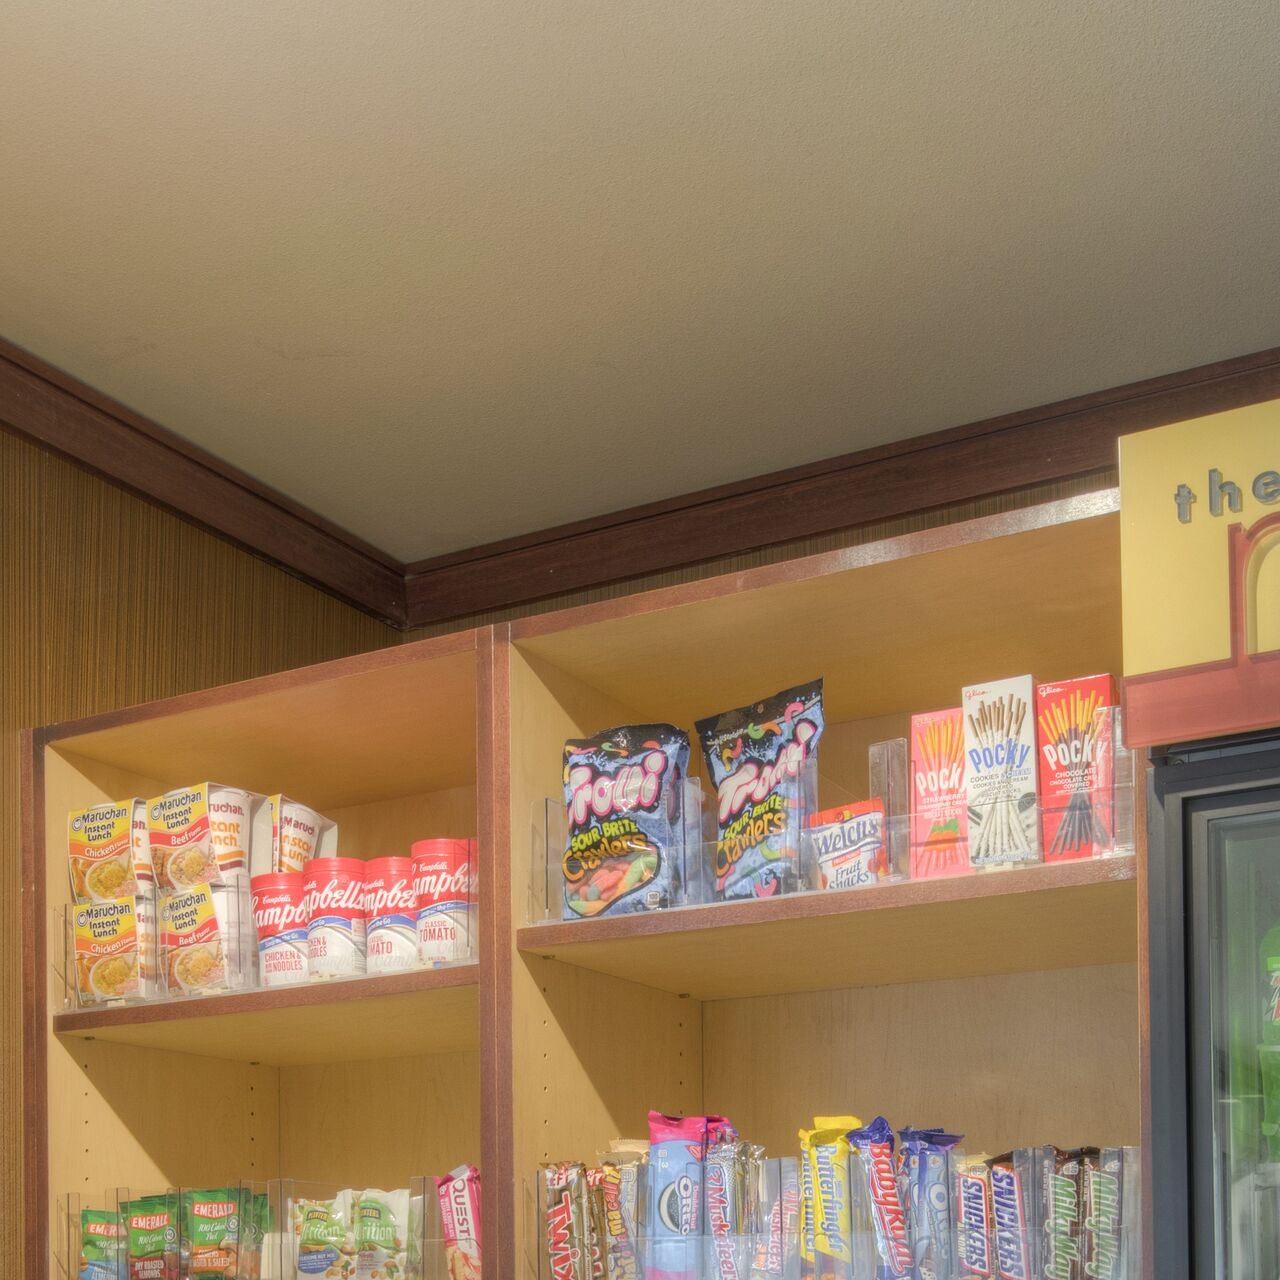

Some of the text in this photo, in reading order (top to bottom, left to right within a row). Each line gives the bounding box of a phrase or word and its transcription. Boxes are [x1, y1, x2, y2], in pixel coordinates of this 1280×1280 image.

[964, 690, 989, 699] Glico
[1039, 686, 1064, 697] Glico
[968, 738, 1032, 773] POCKY
[1043, 733, 1107, 771] POCKY
[159, 791, 202, 811] Maruchan
[82, 808, 127, 823] Maruchan
[162, 808, 192, 822] Instant
[84, 822, 115, 833] Instant
[166, 818, 190, 829] Lunch
[87, 831, 112, 842] Lunch
[171, 832, 189, 845] Beef
[815, 819, 879, 851] Welch's
[85, 845, 115, 857] Chicken
[562, 833, 648, 882] Crawlers
[834, 860, 862, 880] Fruit
[169, 892, 207, 911] Maruchan
[86, 903, 131, 919] Maruchan
[171, 909, 199, 921] Instant
[89, 919, 121, 930] Instant
[174, 918, 197, 930] Lunch
[424, 920, 447, 928] CLASSIC
[93, 928, 117, 938] Lunch
[419, 926, 457, 942] TOMATO
[272, 958, 303, 972] NOODLES
[674, 1174, 692, 1236] OREO
[816, 1144, 842, 1252] Butterfinger
[193, 1204, 235, 1217] EMERALD
[451, 1178, 471, 1237] QUEST
[961, 1176, 988, 1274] SNICKERS
